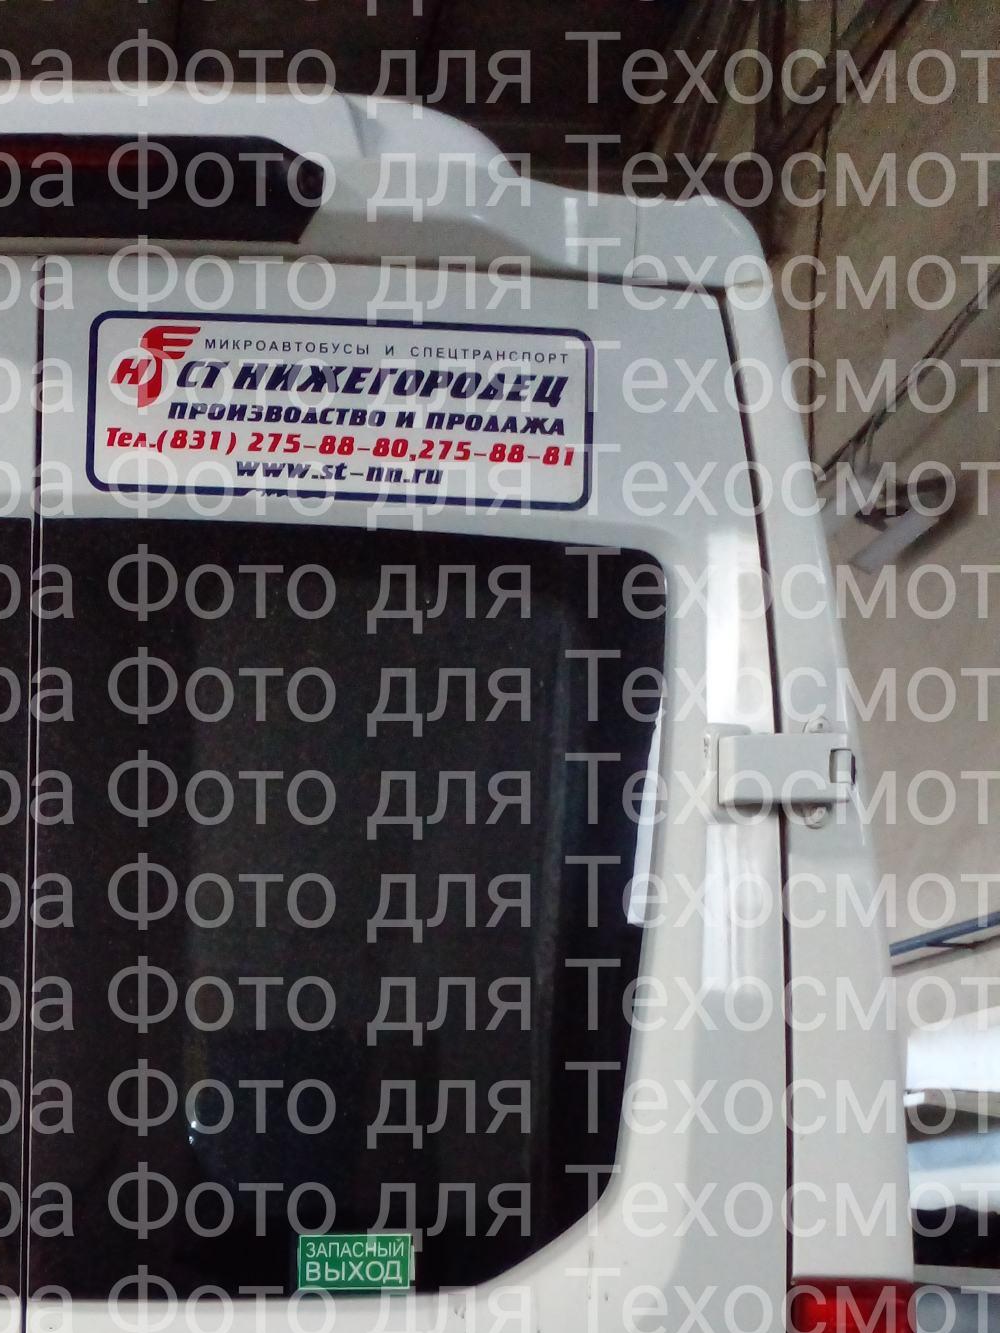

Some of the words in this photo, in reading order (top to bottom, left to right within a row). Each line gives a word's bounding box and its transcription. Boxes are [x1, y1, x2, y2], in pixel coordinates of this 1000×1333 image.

[204, 338, 369, 356] МИКРОАВТОБУСЫ
[384, 345, 395, 356] И
[410, 346, 569, 364] СПЕЦТРАНСПОРТ
[176, 360, 230, 389] СТ
[232, 362, 569, 407] НИЖЕГОРОДЕЦ
[168, 401, 386, 427] ПРОИЗВОДСТВО
[395, 411, 416, 428] И
[425, 412, 565, 436] ПРОДАЖА
[236, 460, 444, 485] www.st-nn.ru
[305, 1239, 404, 1258] ЗАПАСНЫЙ
[305, 1260, 402, 1284] ВЫХОД
